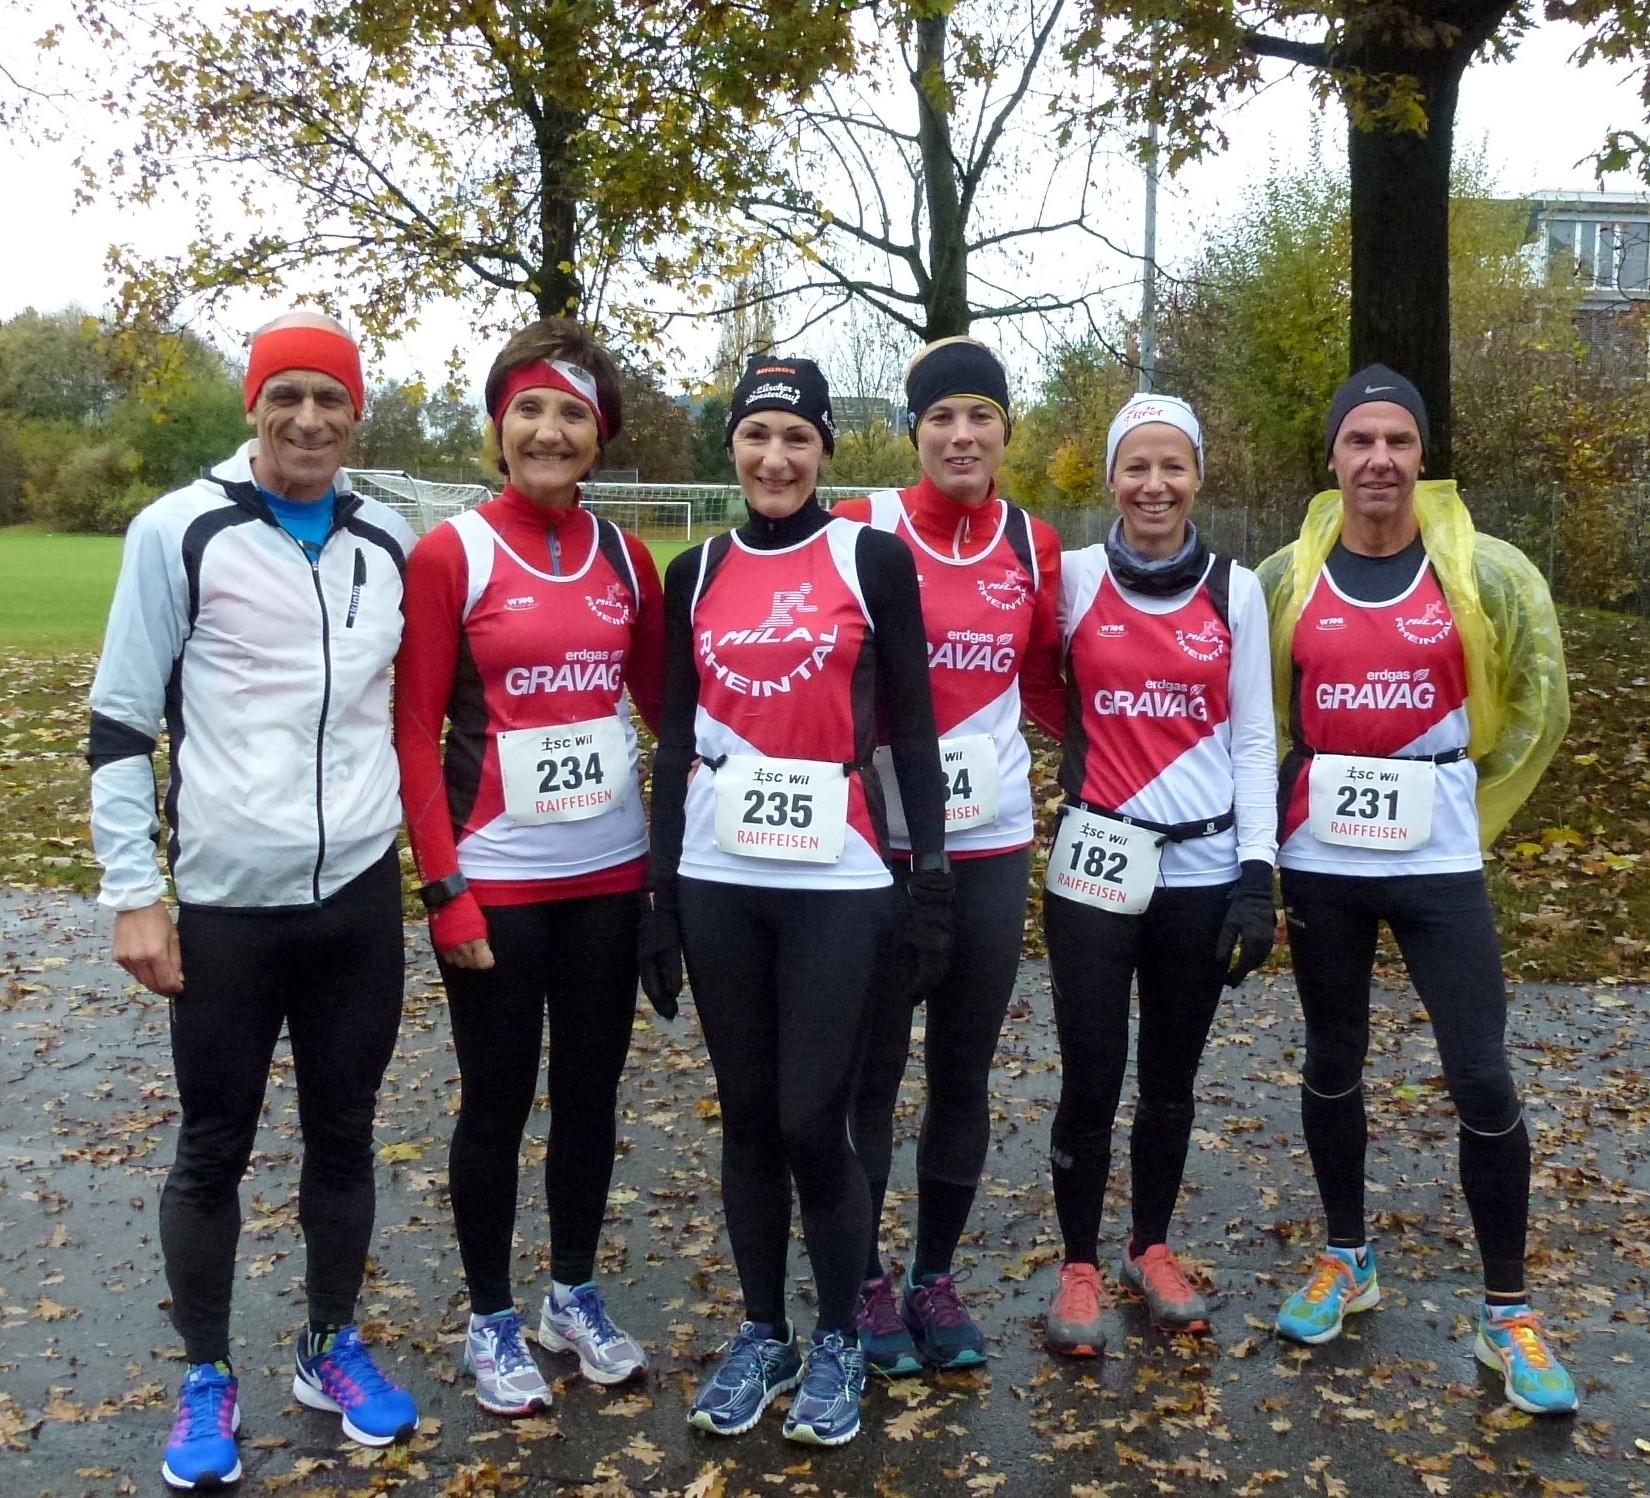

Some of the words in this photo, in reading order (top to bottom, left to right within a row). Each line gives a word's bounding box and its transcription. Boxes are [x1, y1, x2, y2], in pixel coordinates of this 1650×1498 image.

[947, 630, 994, 643] erdgas
[565, 649, 608, 662] erdgas
[700, 624, 838, 697] RHEINTAL
[927, 643, 1015, 673] AVAG
[506, 664, 621, 695] GRAVAG
[1145, 679, 1188, 692] erdgas
[1367, 670, 1410, 681] erdgas
[1094, 690, 1208, 721] GRAVAG
[1316, 683, 1436, 709] GRAVAG
[575, 734, 593, 747] Wil
[945, 751, 963, 762] Wil
[536, 752, 604, 793] 234
[789, 774, 810, 785] Wil
[1379, 772, 1399, 782] Wil
[535, 789, 613, 813] RAIFFEISEN
[742, 790, 813, 828] 235
[1336, 786, 1400, 821] 231
[945, 805, 980, 821] EISEN
[737, 829, 819, 850] RAIFFEISEN
[1109, 834, 1128, 846] Wil
[1331, 821, 1408, 839] RAIFFEISEN
[1070, 840, 1128, 884] 182
[1057, 872, 1128, 904] RAIFFEISEN
